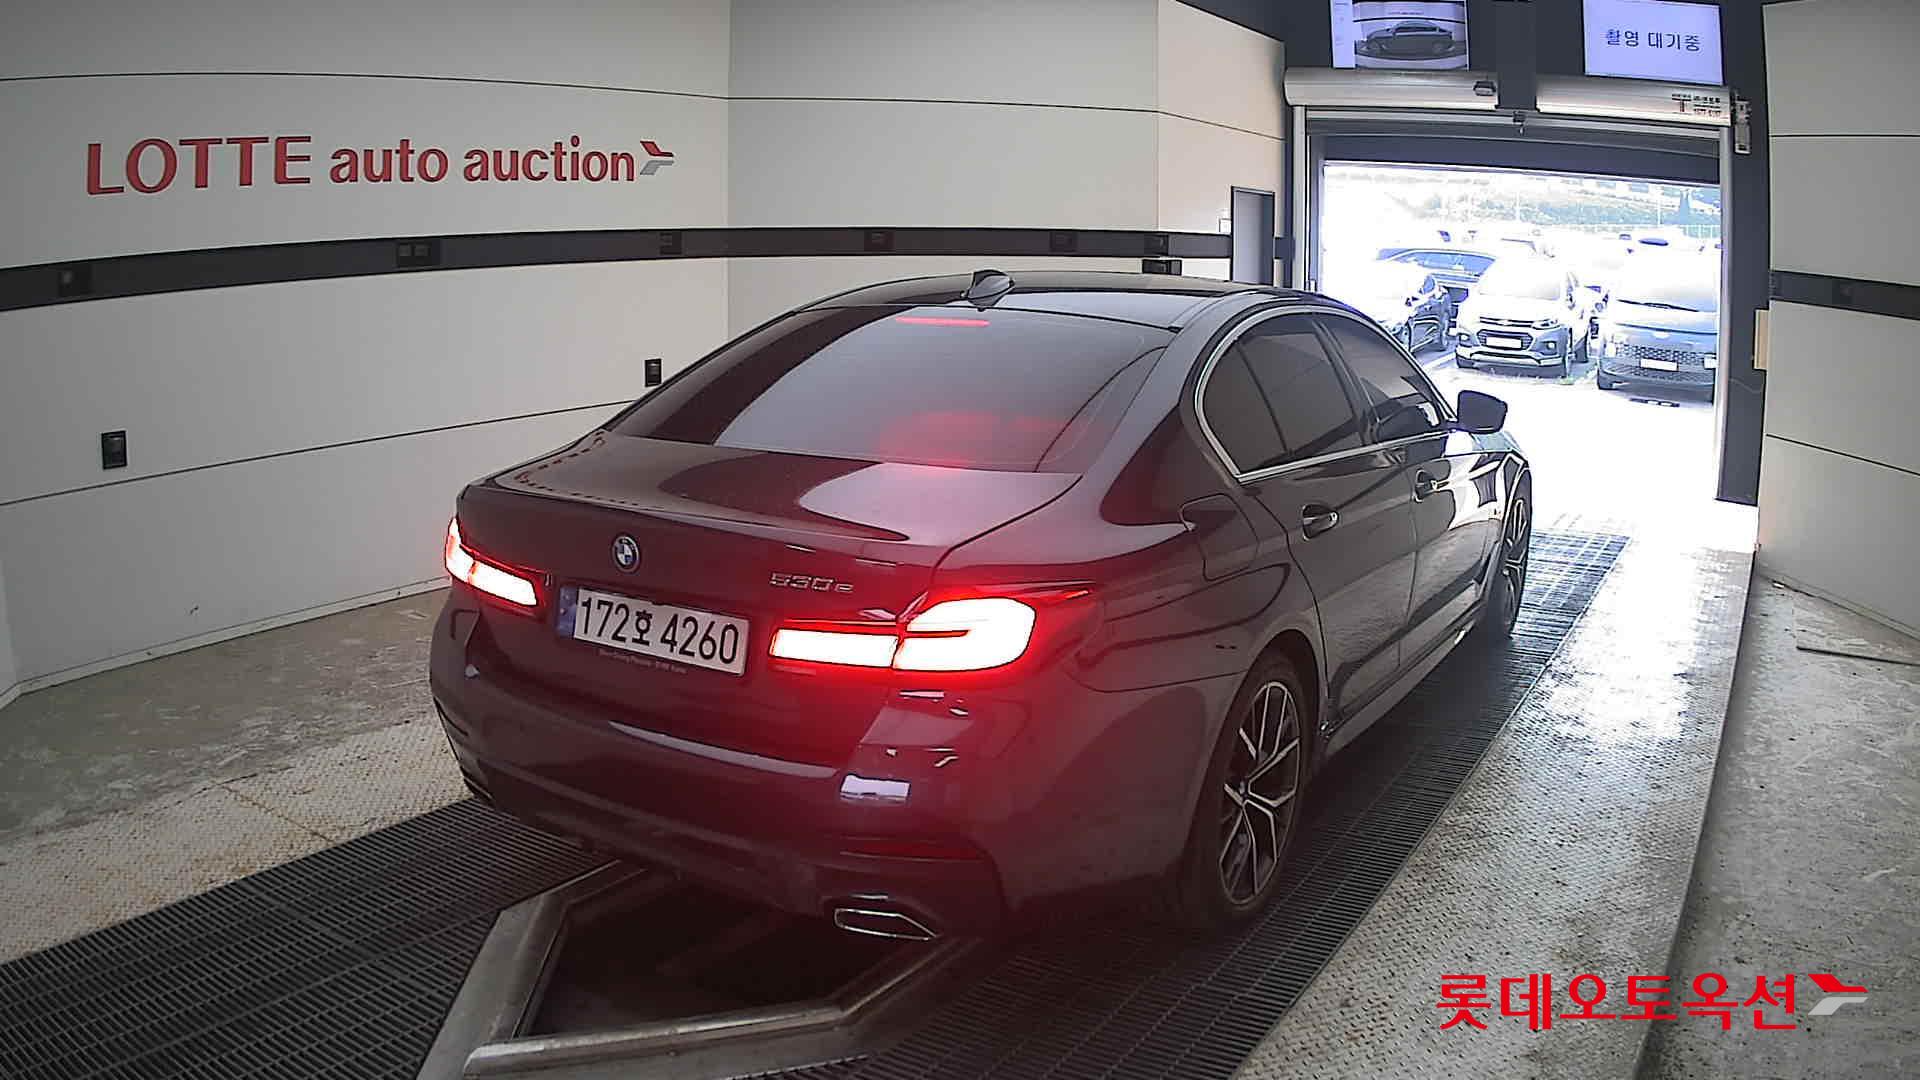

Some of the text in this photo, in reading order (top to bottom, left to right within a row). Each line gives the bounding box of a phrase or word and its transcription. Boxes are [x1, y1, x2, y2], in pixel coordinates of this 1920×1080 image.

[1647, 31, 1701, 52] 대기중
[86, 135, 634, 196] LOTTE auto auction
[582, 597, 653, 647] 172호
[660, 613, 739, 664] 4260
